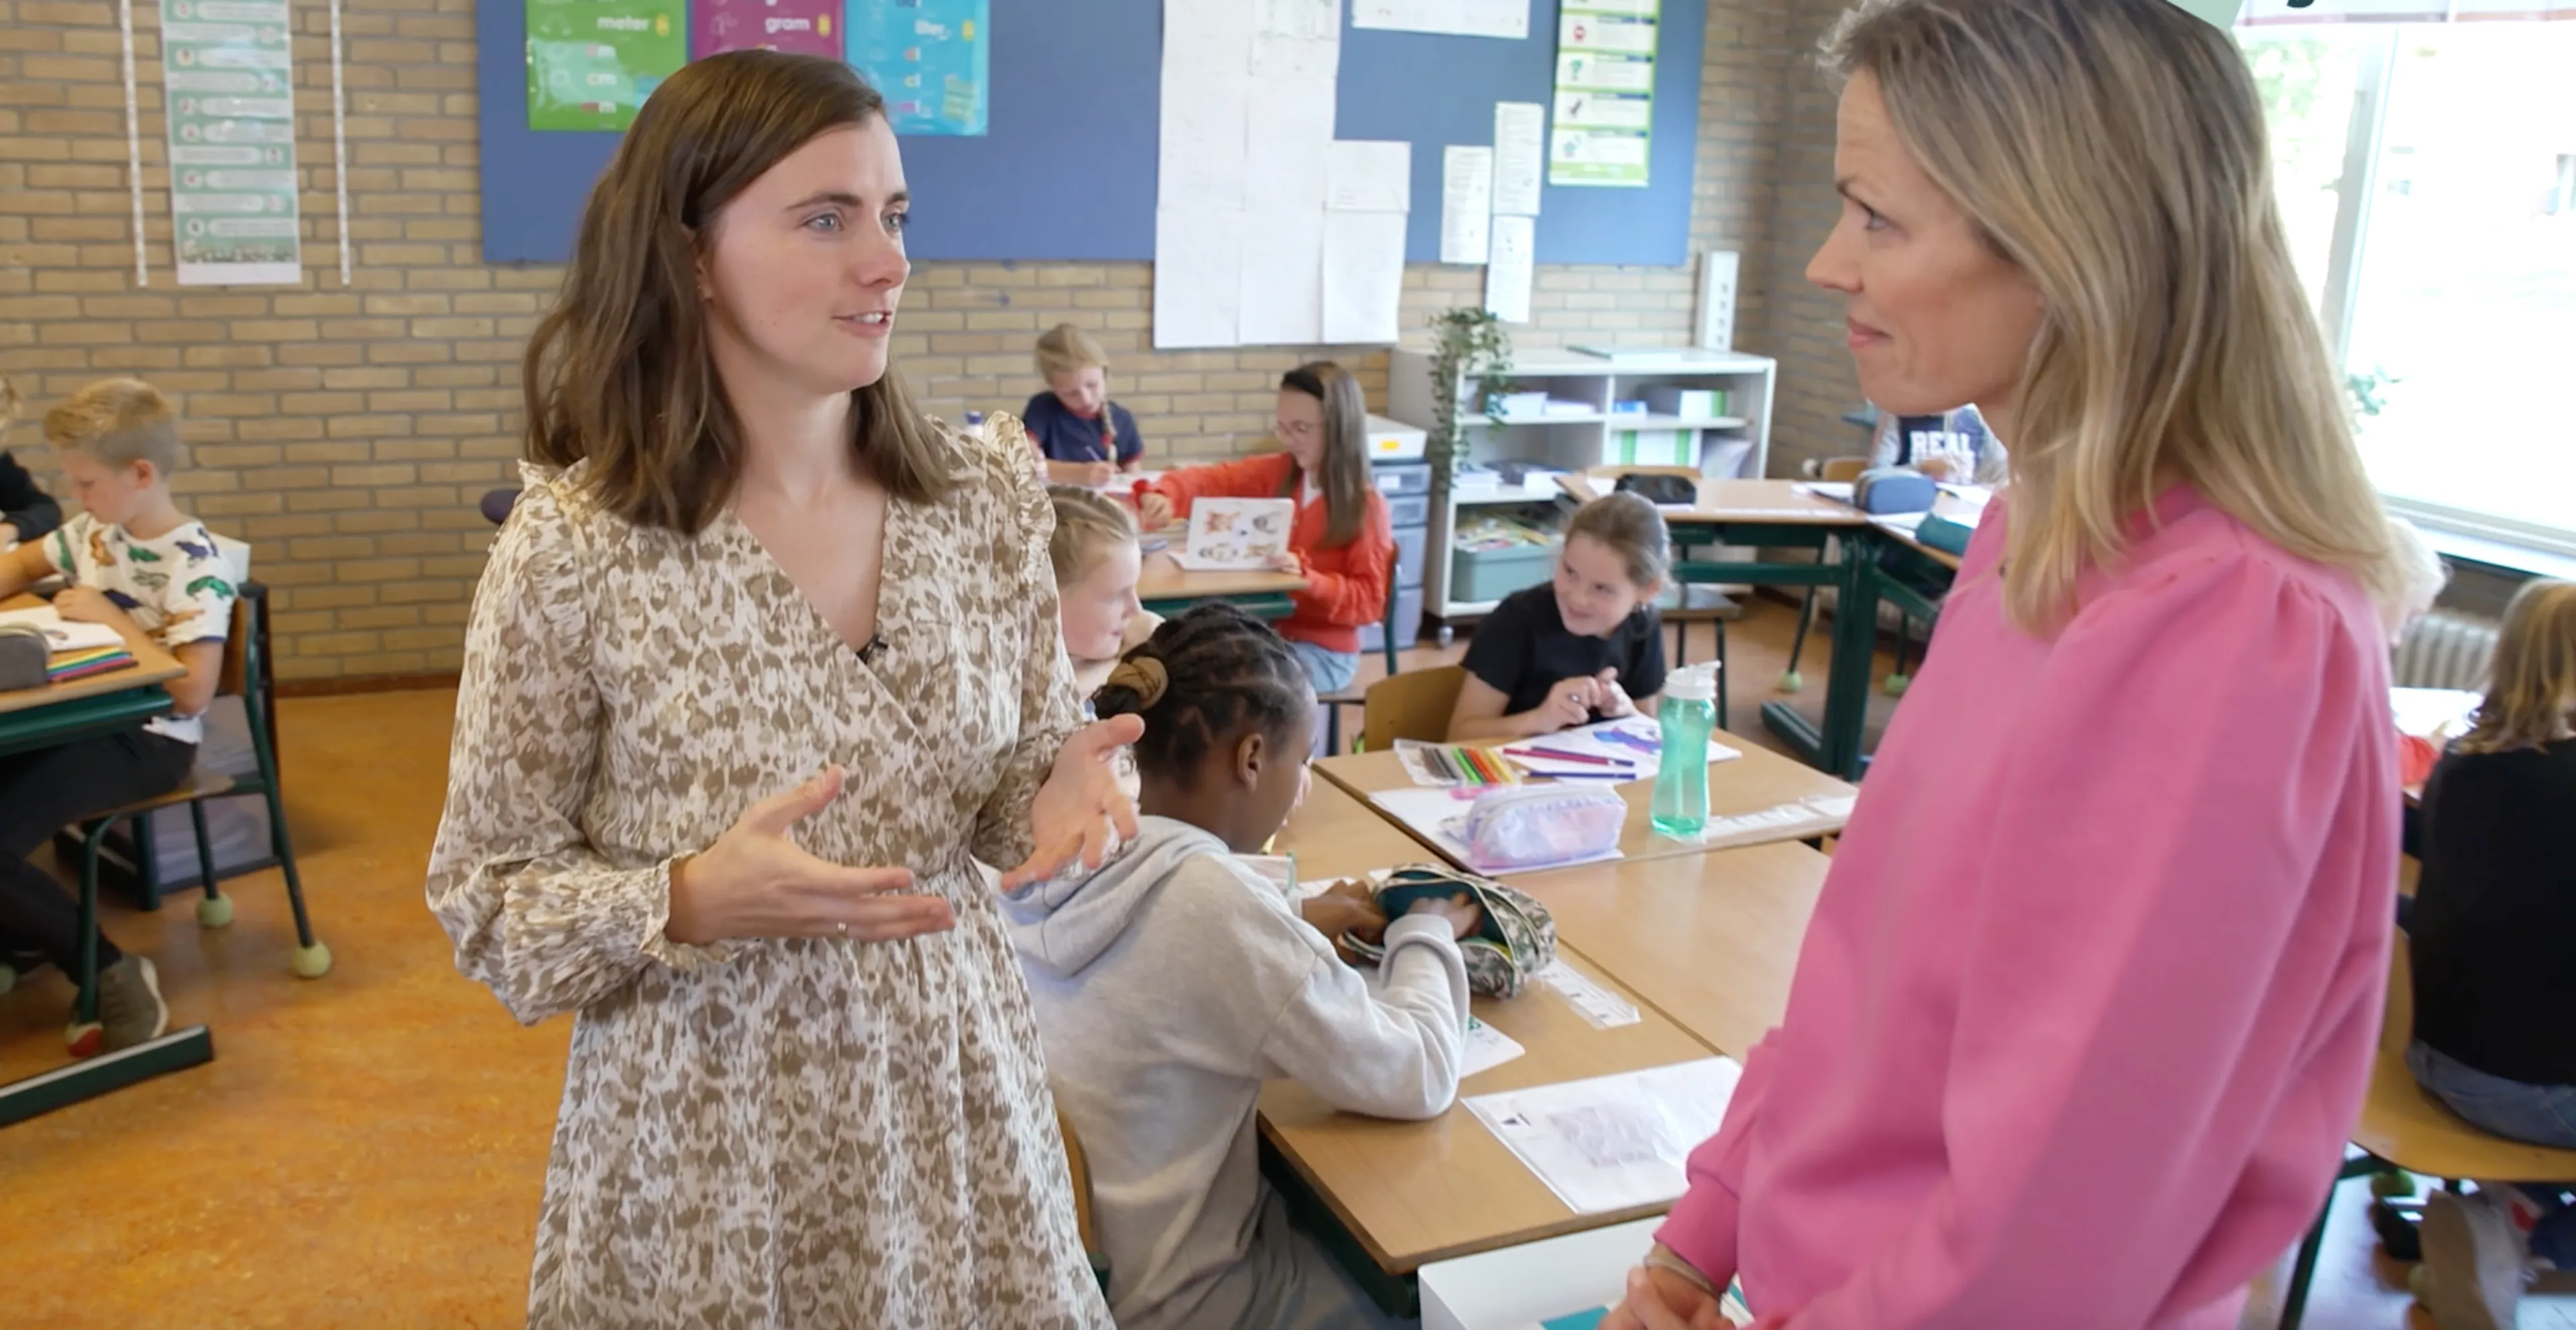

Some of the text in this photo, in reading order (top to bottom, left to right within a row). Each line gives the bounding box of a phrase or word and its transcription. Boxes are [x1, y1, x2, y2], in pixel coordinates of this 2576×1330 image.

[596, 15, 649, 31] meter
[765, 17, 810, 34] gram
[1910, 430, 1976, 456] REAL
